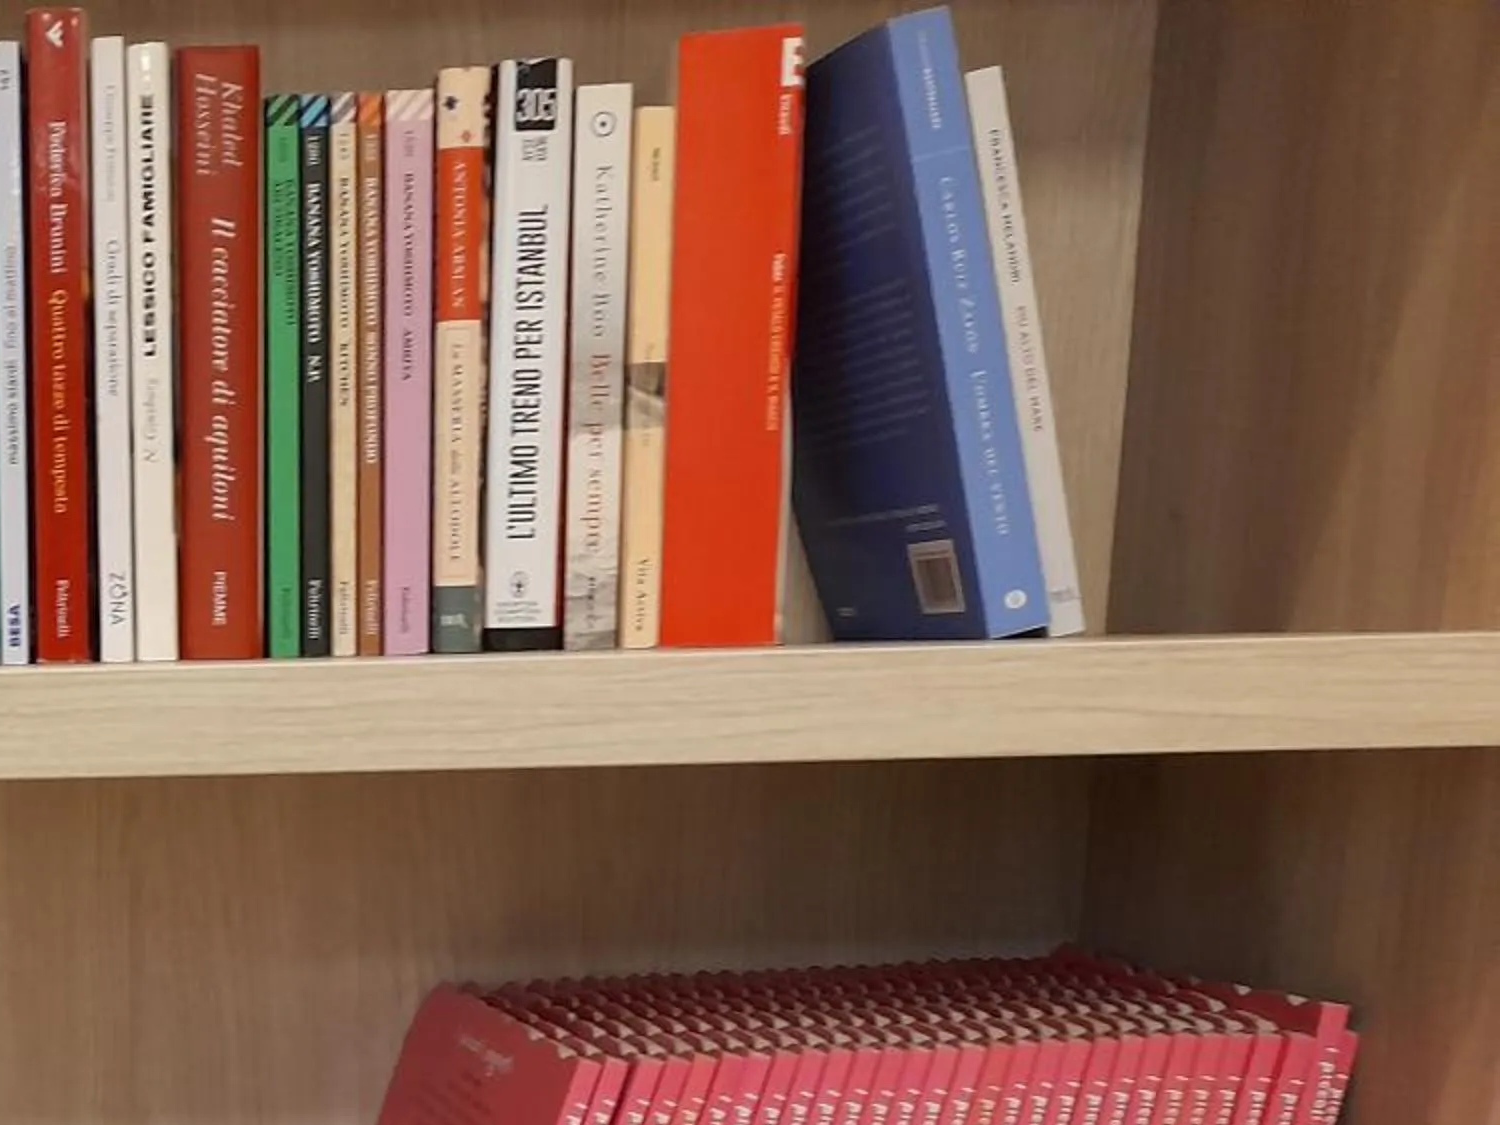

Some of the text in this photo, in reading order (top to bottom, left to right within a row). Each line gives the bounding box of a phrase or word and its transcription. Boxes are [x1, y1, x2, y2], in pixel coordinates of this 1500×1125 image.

[48, 120, 68, 197] Federica
[220, 81, 244, 167] Khaled
[140, 95, 158, 357] LESSICO FAMIGLIARE
[305, 183, 322, 246] BANANA
[450, 159, 467, 239] ANTONIA
[592, 164, 615, 287] Katherine
[50, 203, 70, 274] Brunini
[48, 289, 70, 360] Quattro
[306, 250, 323, 343] YOSHIMOTO
[591, 294, 611, 337] Boo
[507, 206, 548, 539] L'ULTIMO TRENO PER ISTANBUL
[590, 353, 611, 406] Belle
[53, 414, 71, 432] di
[203, 217, 237, 626] Il cacciatore di aquiloni PIEMME
[585, 422, 606, 458] per
[48, 437, 69, 514] tempesta
[579, 469, 606, 553] sempre
